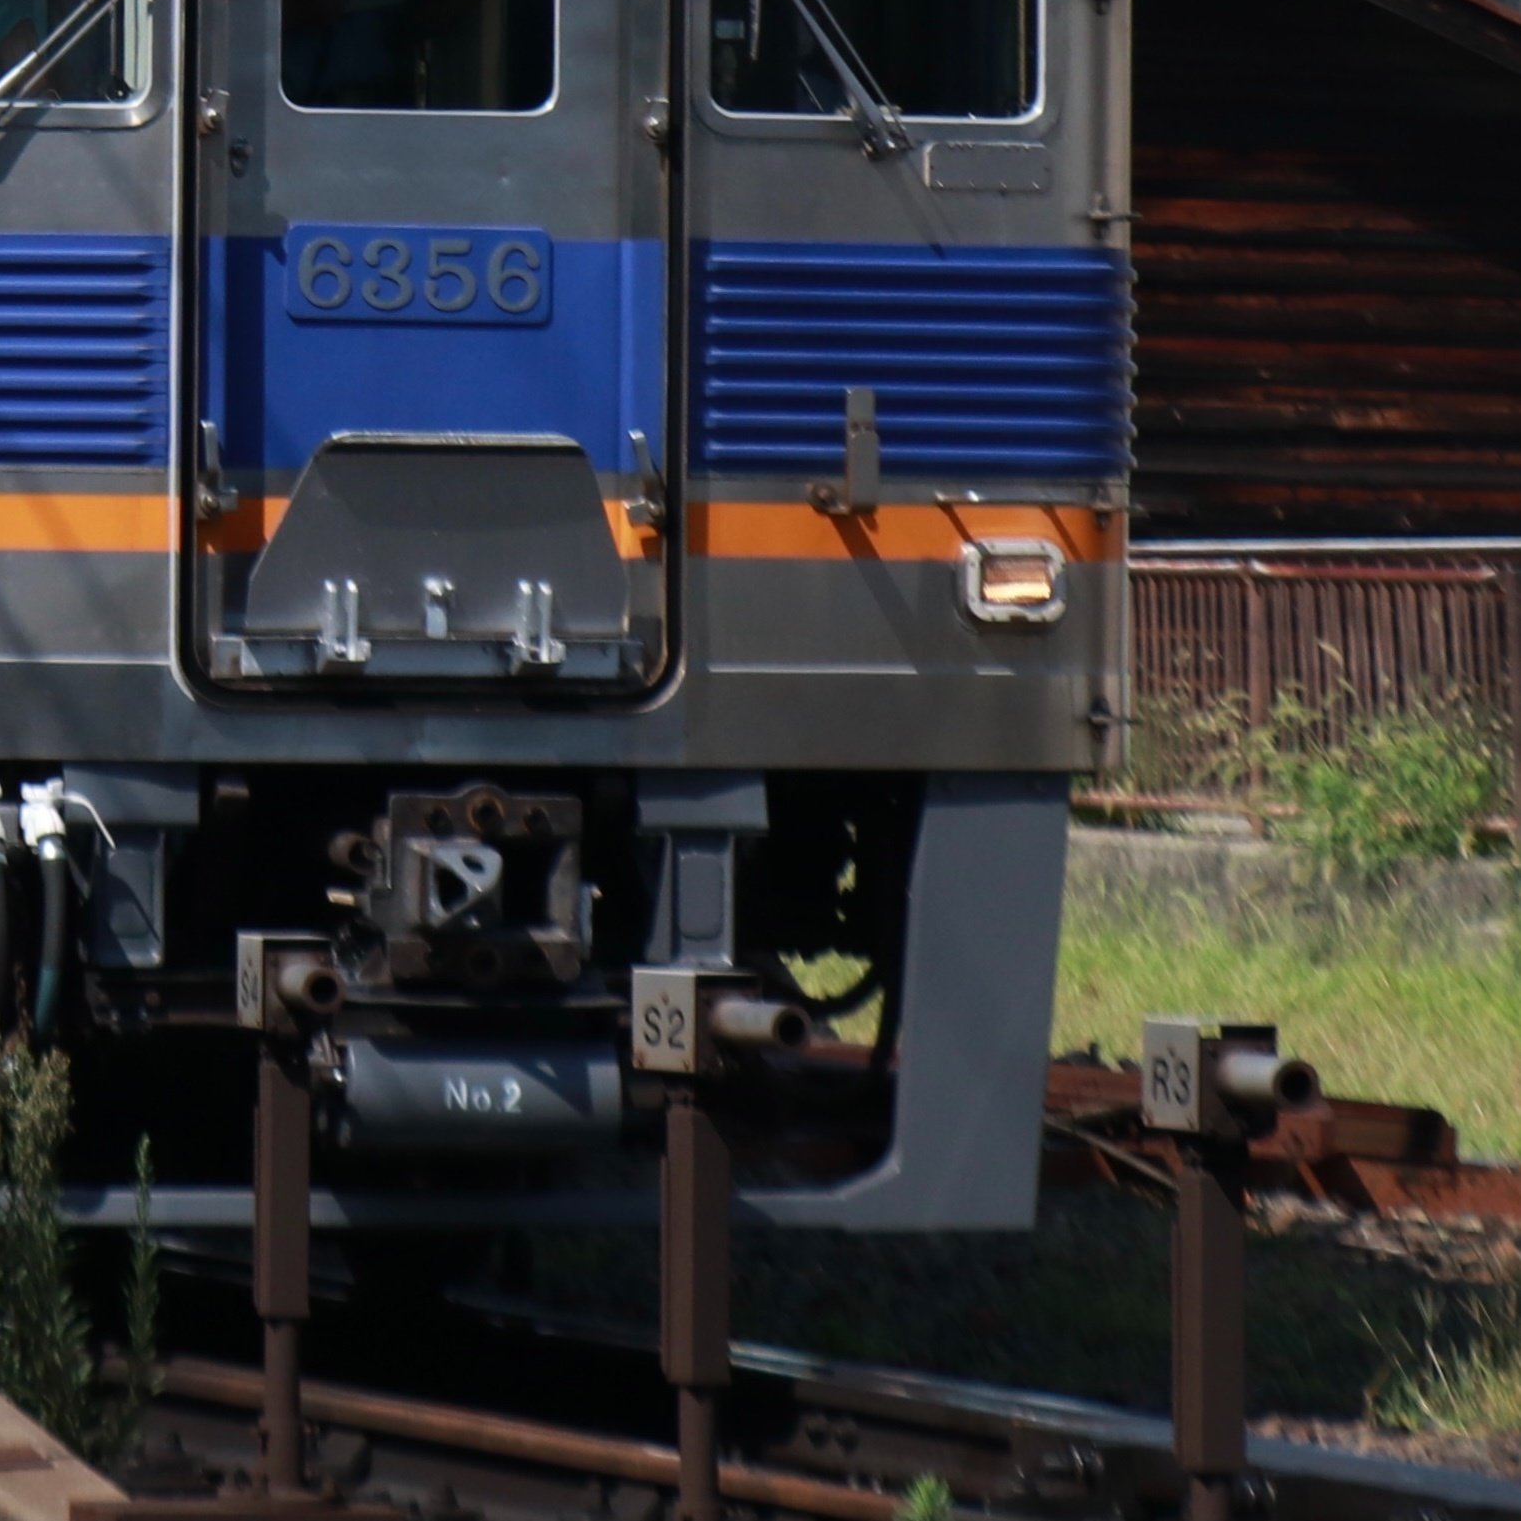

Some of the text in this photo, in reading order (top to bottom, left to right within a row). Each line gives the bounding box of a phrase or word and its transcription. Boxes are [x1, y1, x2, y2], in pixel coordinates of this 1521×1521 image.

[297, 236, 542, 313] 6356
[641, 1006, 687, 1051] S2
[442, 1077, 523, 1114] No.2
